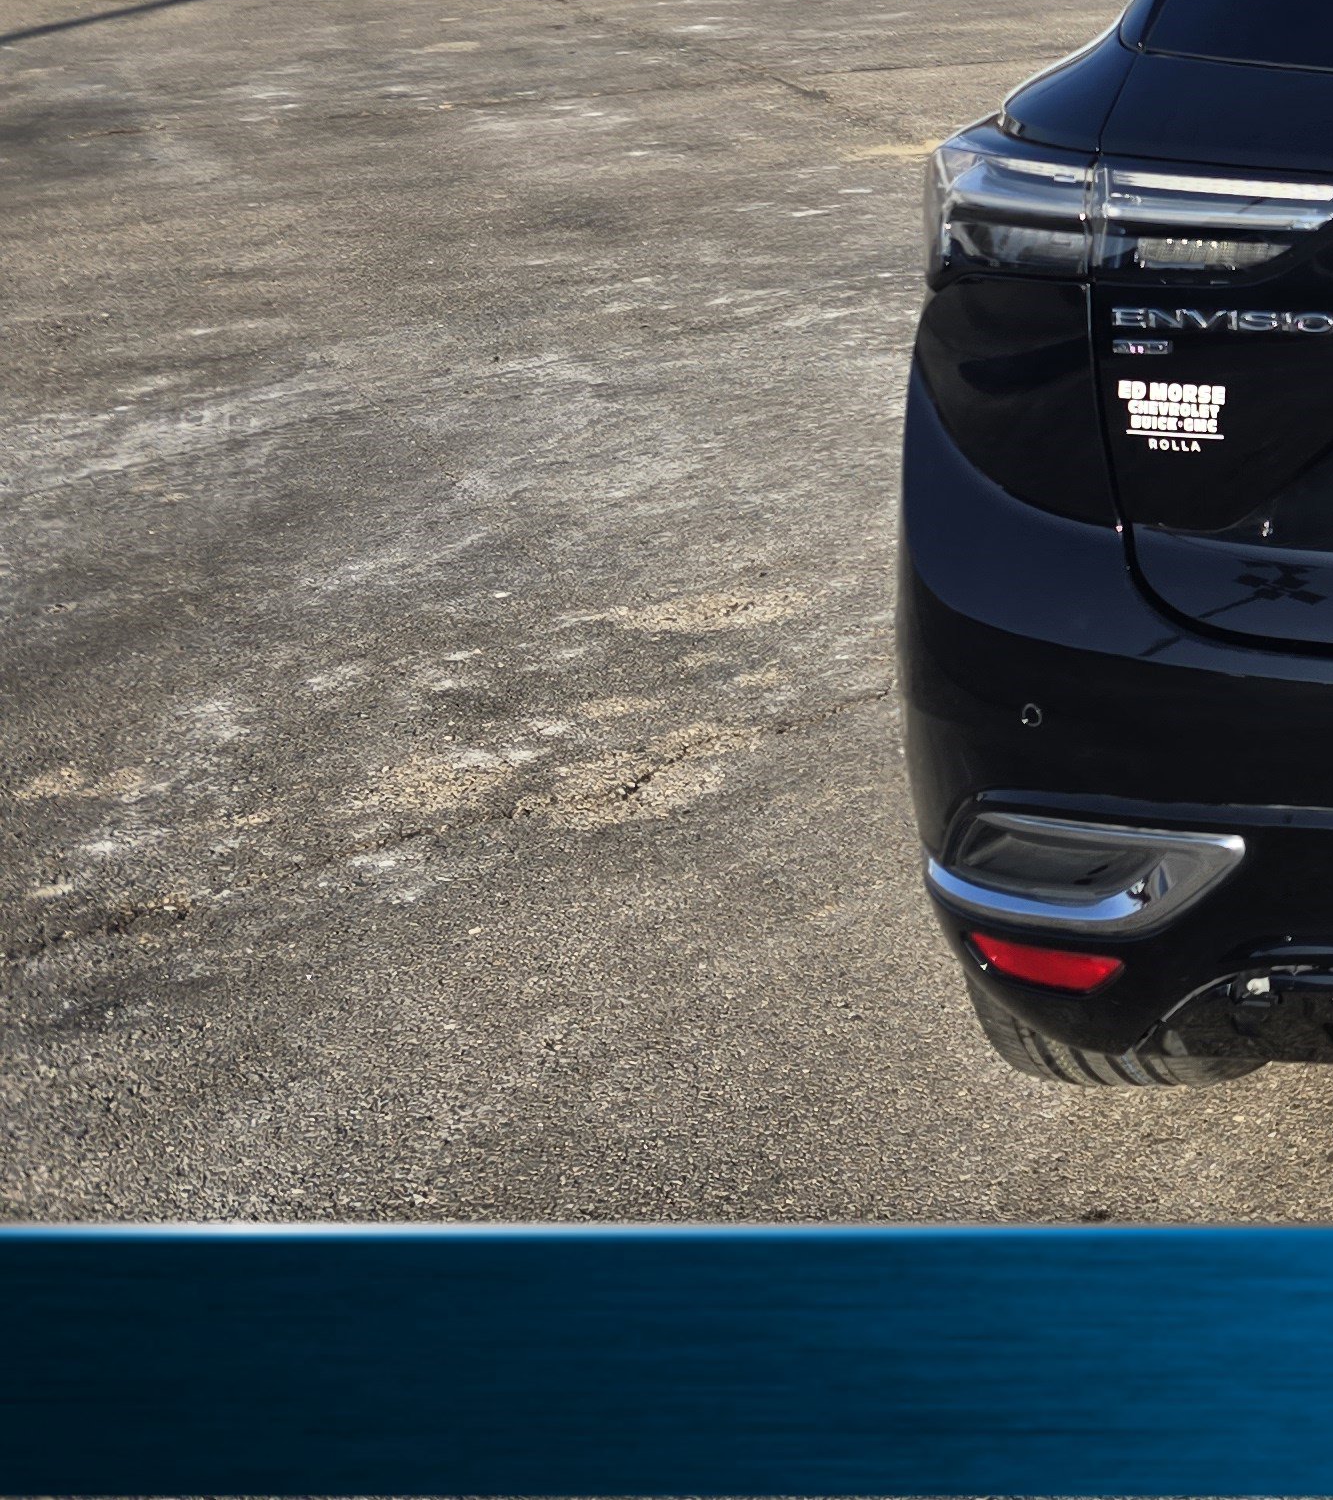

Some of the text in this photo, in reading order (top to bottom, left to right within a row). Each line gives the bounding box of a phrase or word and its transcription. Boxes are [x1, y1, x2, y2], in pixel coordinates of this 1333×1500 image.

[1118, 380, 1226, 405] ED MORSE
[1127, 399, 1220, 419] CHEVROLET
[1148, 438, 1201, 453] ROLLA
